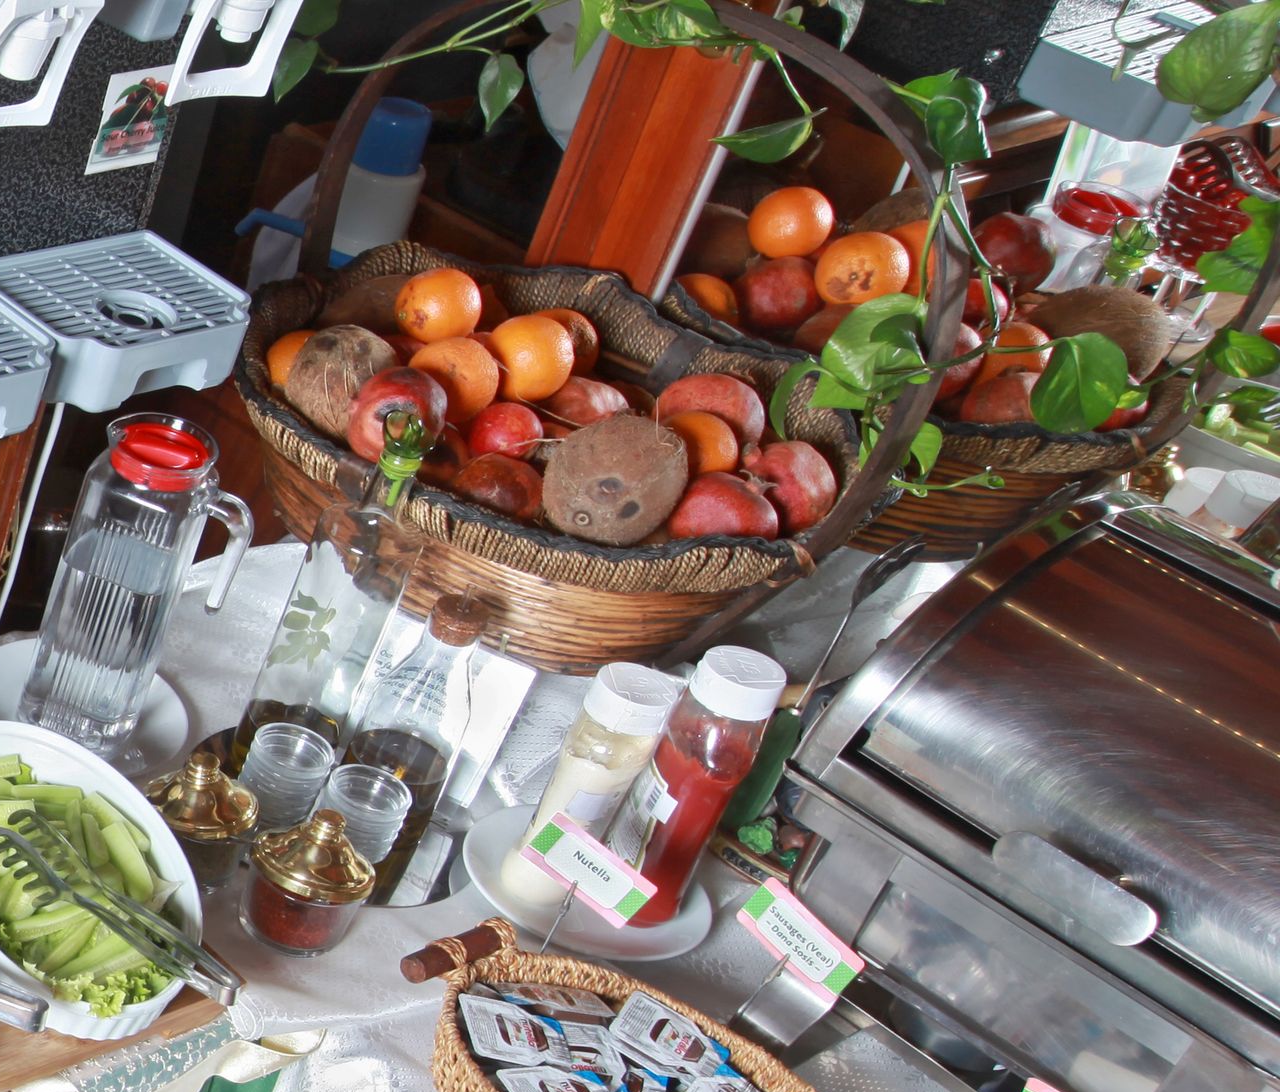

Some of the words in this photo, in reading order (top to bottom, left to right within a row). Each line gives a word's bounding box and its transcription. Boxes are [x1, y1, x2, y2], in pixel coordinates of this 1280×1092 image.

[573, 850, 611, 882] Nutella
[769, 905, 807, 944] Sausages
[806, 941, 834, 969] (Veal)
[771, 924, 793, 947] Dana
[792, 945, 814, 967] Sosis
